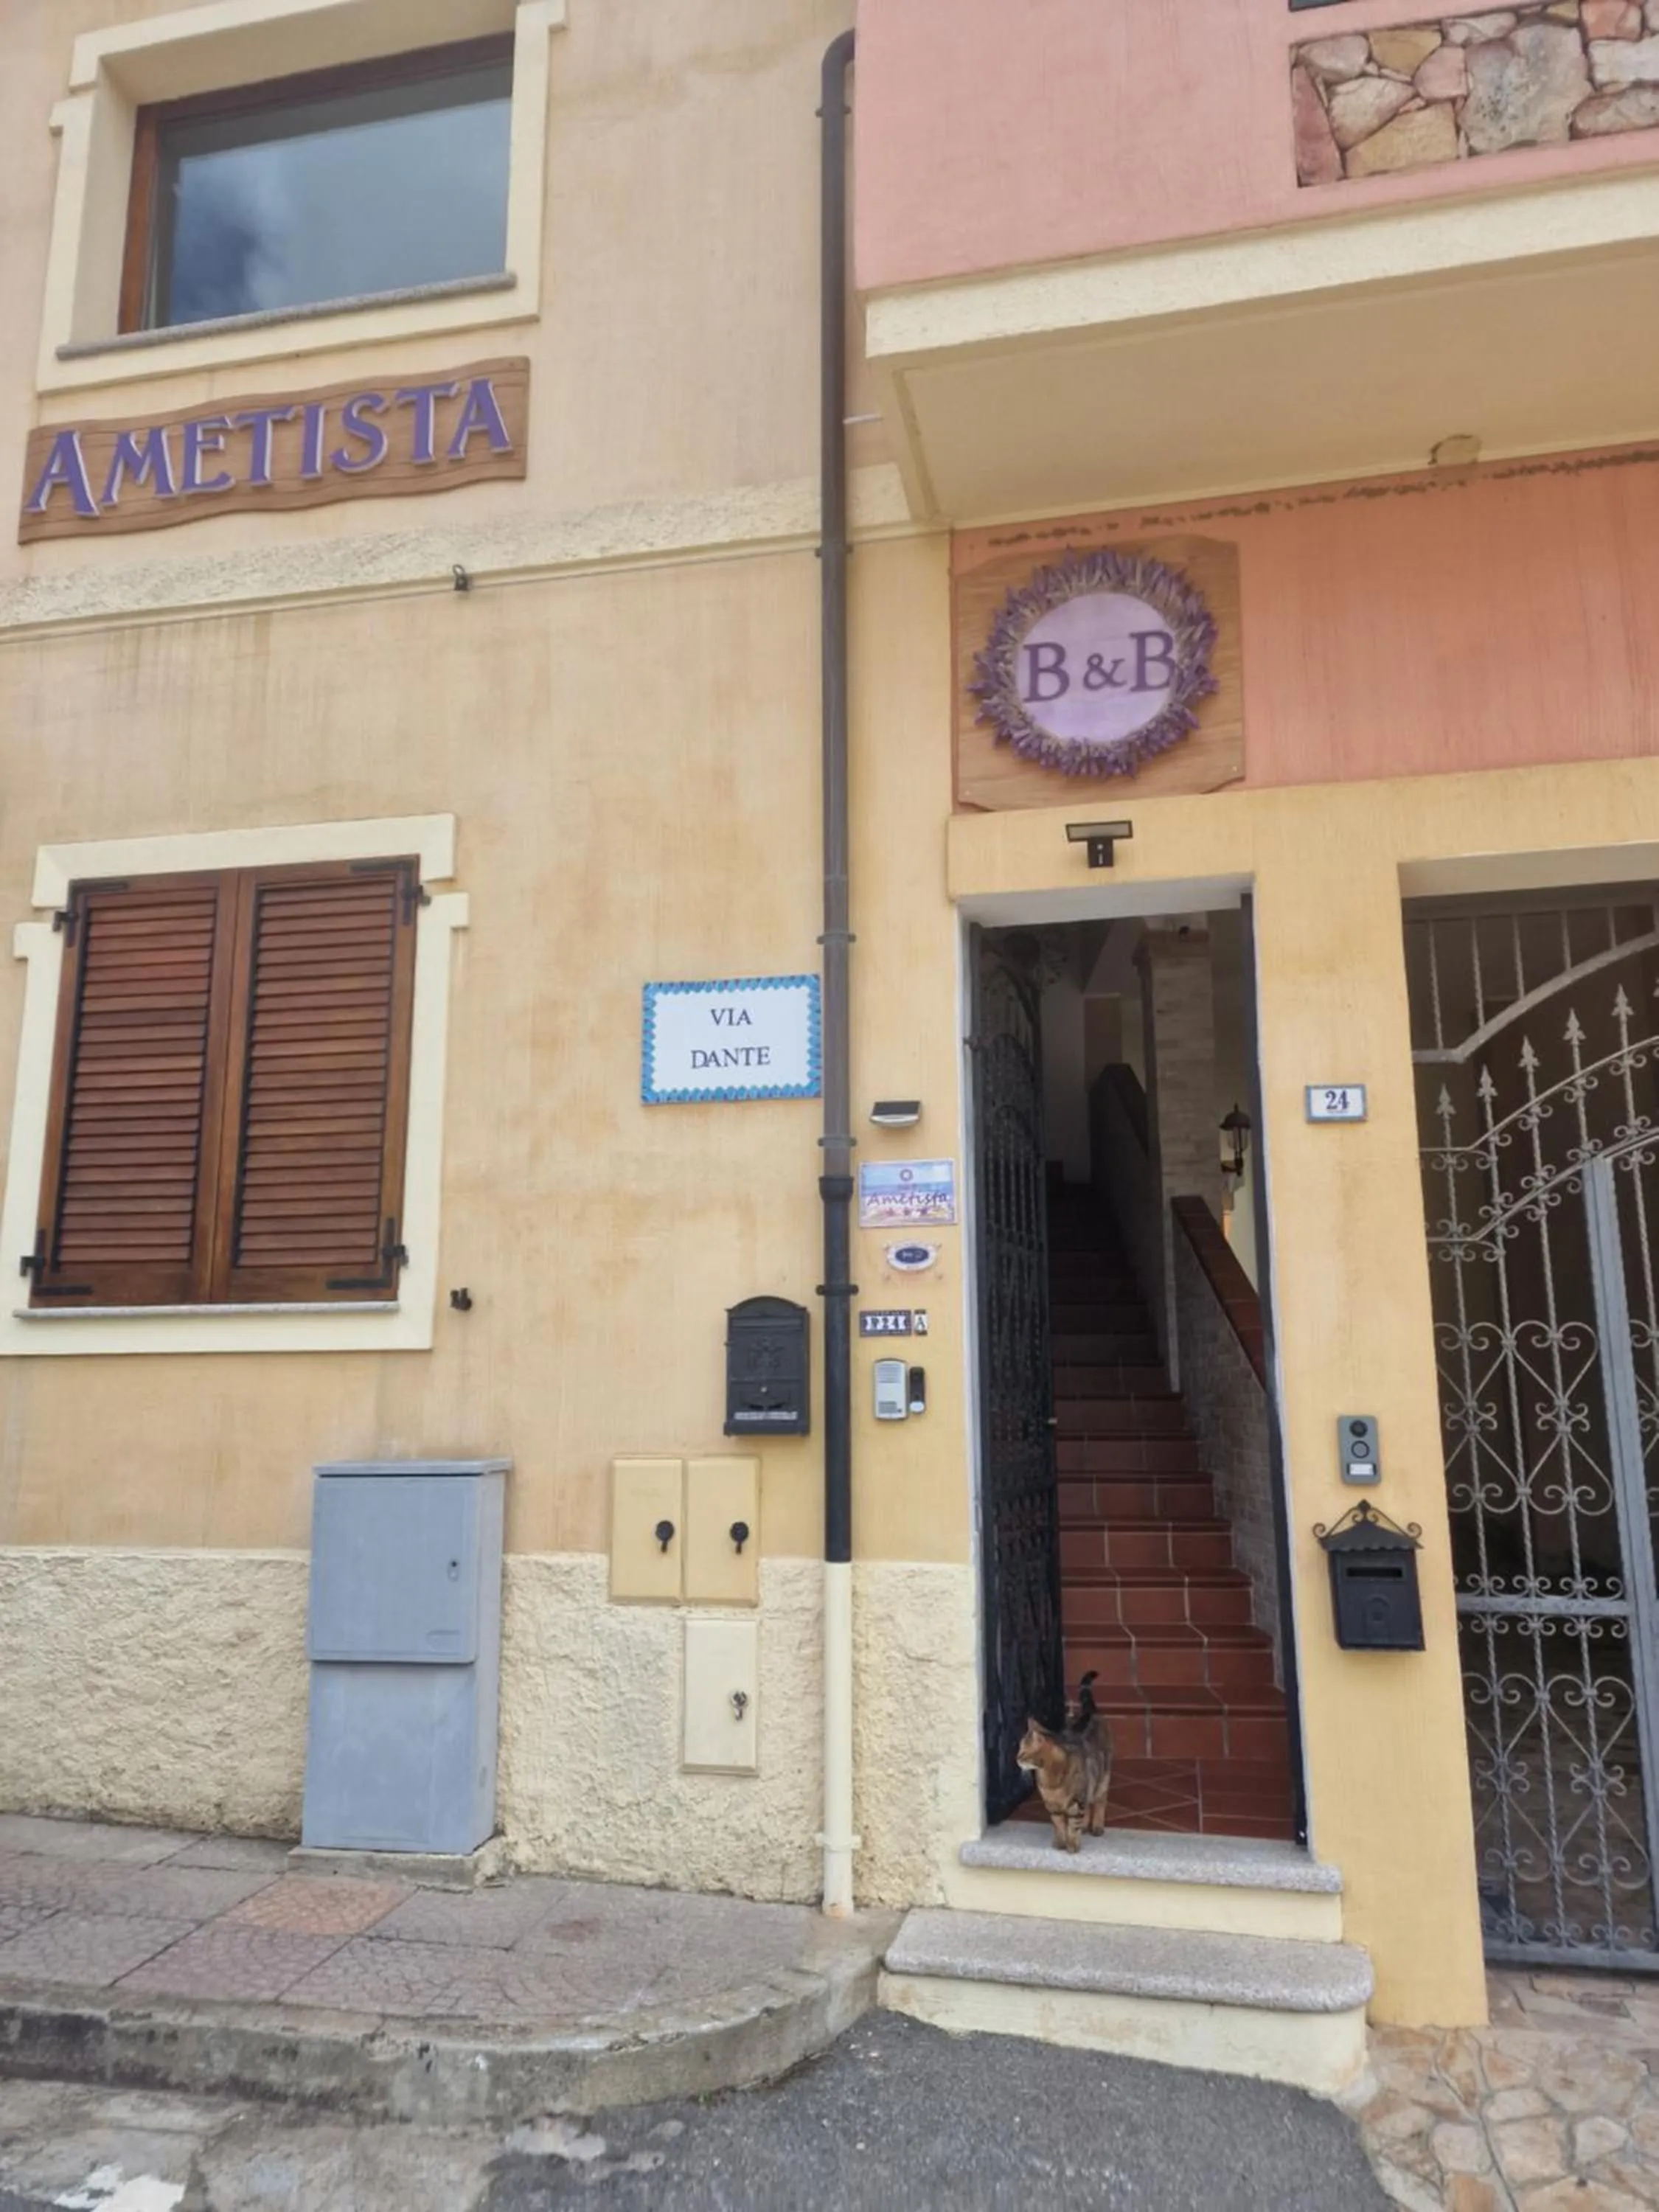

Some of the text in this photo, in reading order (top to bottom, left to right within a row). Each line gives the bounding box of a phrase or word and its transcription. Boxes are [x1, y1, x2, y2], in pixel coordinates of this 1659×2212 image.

[25, 378, 513, 517] AMETISTA
[1023, 630, 1178, 703] B&B
[710, 1007, 753, 1026] VIA
[690, 1046, 771, 1070] DANTE
[1324, 1089, 1350, 1110] 24
